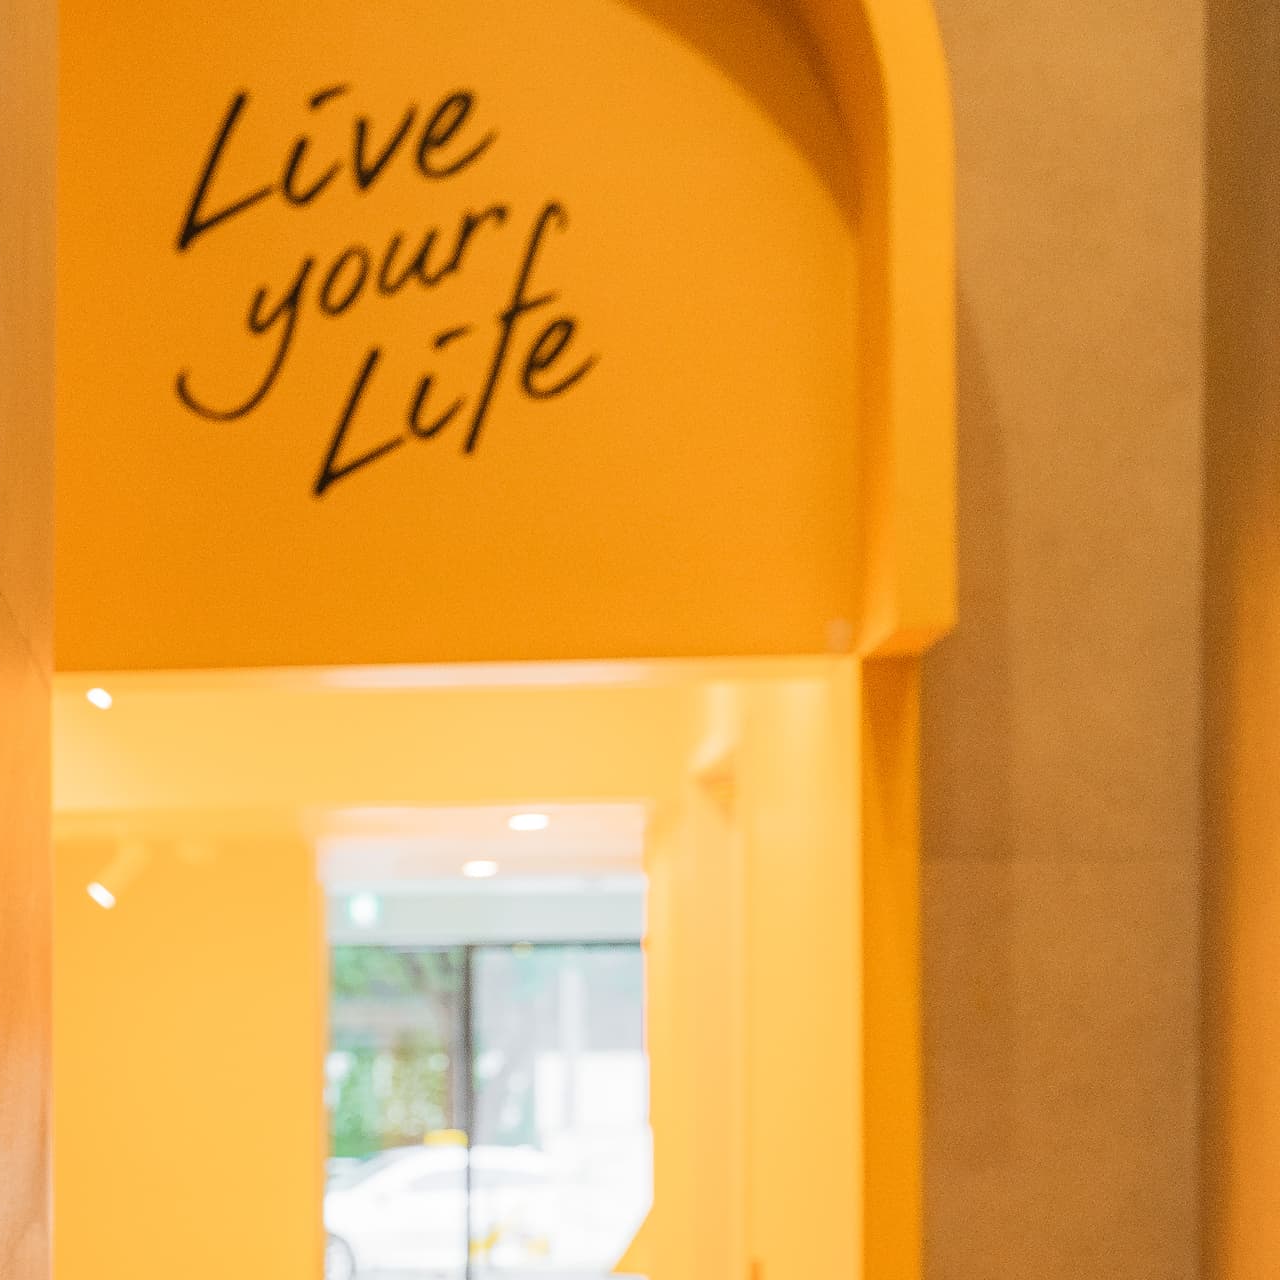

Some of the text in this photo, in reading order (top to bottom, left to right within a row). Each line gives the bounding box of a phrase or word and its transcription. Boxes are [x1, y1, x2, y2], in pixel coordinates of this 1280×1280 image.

[175, 82, 500, 254] Live
[174, 202, 509, 422] your
[313, 199, 601, 499] Life
